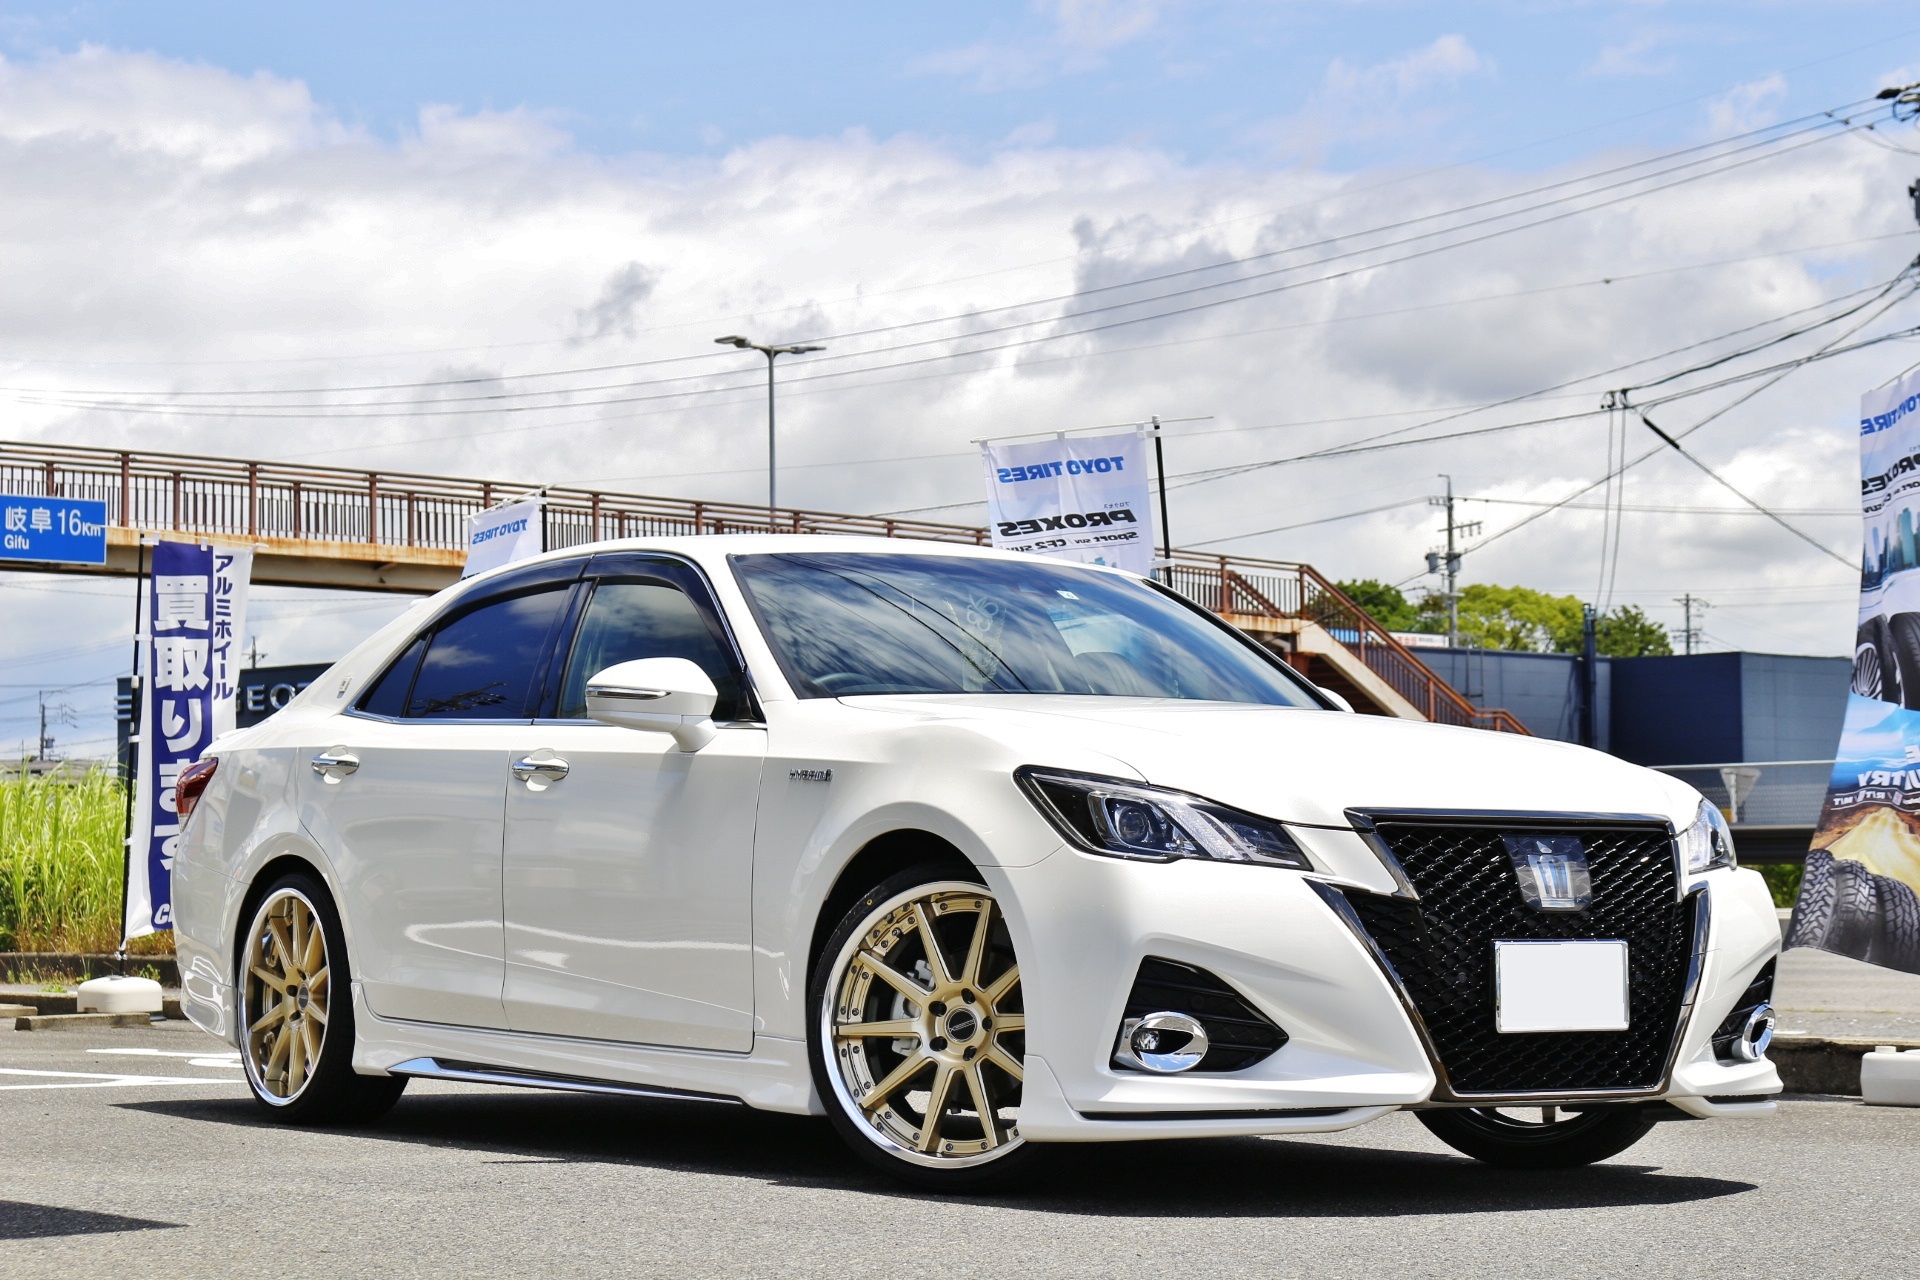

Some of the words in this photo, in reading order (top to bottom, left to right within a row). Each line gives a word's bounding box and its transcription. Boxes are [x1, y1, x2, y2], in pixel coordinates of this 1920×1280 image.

[5, 506, 53, 534] 岐阜
[4, 534, 30, 550] Gifu
[213, 555, 234, 701] アルミホイール
